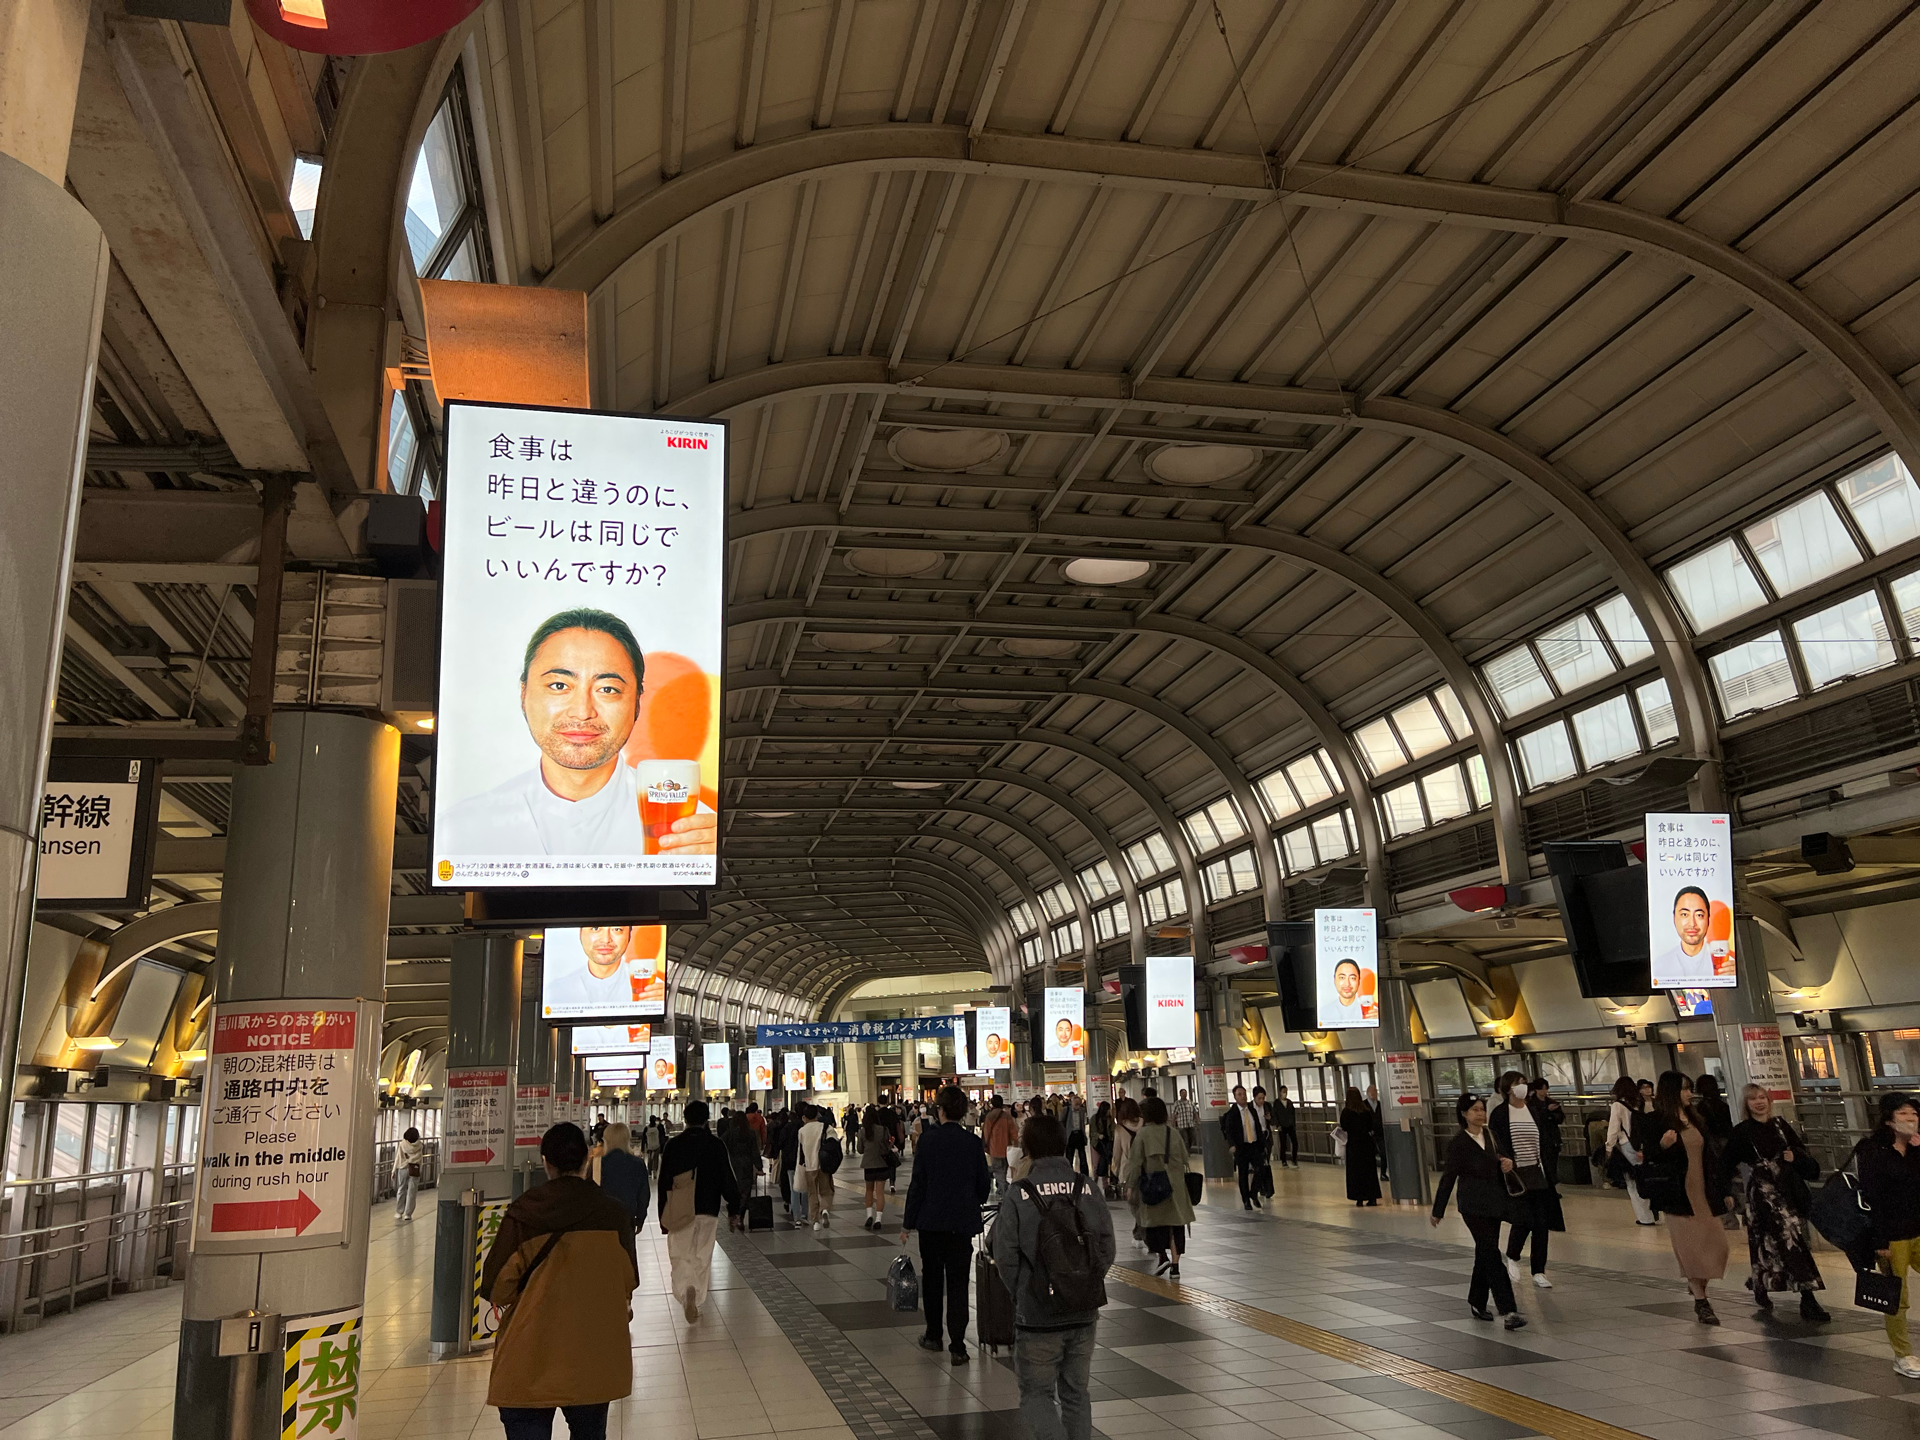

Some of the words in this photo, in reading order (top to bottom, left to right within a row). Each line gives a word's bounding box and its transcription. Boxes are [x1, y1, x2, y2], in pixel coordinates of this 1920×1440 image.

[488, 433, 573, 462] 食事は
[667, 436, 708, 450] KIRIN
[488, 474, 690, 510] 昨日と違うのに、
[487, 515, 679, 548] ビールは同じで
[486, 558, 667, 587] いいんですか?
[649, 790, 668, 799] SPRING
[669, 790, 688, 799] VALLEY
[1658, 822, 1684, 833] 食事は
[1658, 838, 1721, 848] 昨日と違うのに、
[1659, 852, 1718, 862] ビールは同じで
[1659, 867, 1715, 877] いいんですか?
[1158, 999, 1184, 1007] KIRIN
[218, 1012, 351, 1031] 品川駅からのおねがい
[848, 1017, 958, 1036] 消費税インボイス制
[247, 1033, 310, 1047] NOTICE
[223, 1054, 336, 1074] 朝の混雑時は
[223, 1077, 330, 1101] 通路中央を
[212, 1104, 341, 1125] ご通行ください
[244, 1131, 297, 1144] Please
[203, 1154, 230, 1168] walk
[234, 1152, 249, 1167] in
[255, 1150, 283, 1165] the
[289, 1147, 346, 1163] middle
[212, 1175, 251, 1190] during
[256, 1172, 290, 1187] rush
[296, 1170, 329, 1184] hour
[1020, 1182, 1092, 1200] BLENCIA
[1863, 1294, 1888, 1306] SHIRO
[297, 1334, 361, 1439] 禁
